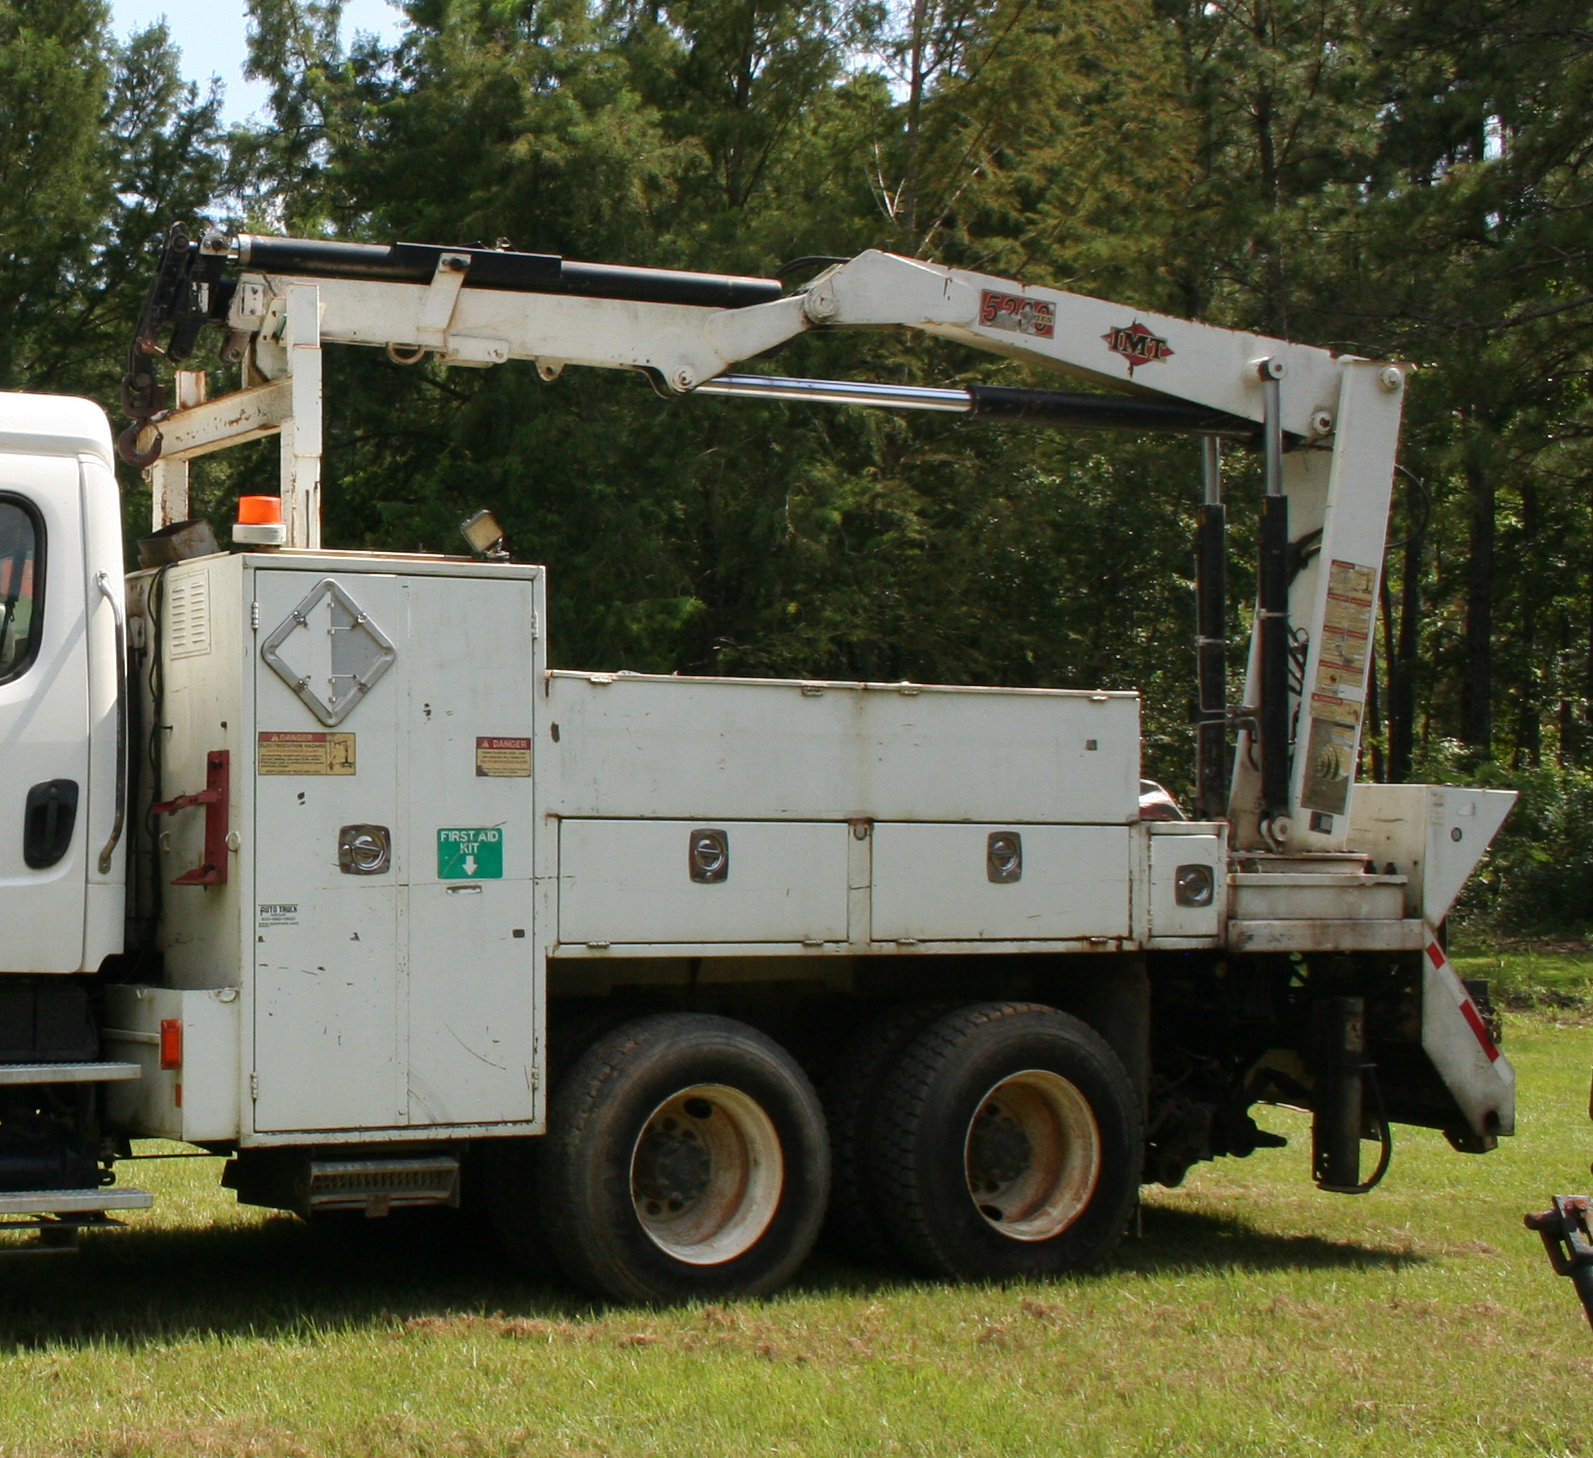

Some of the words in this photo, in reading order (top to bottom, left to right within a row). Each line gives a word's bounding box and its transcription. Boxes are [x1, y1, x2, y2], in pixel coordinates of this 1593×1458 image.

[1109, 328, 1167, 360] IMT
[440, 830, 476, 842] FIRST
[478, 830, 499, 842] AID
[460, 842, 480, 854] KIT
